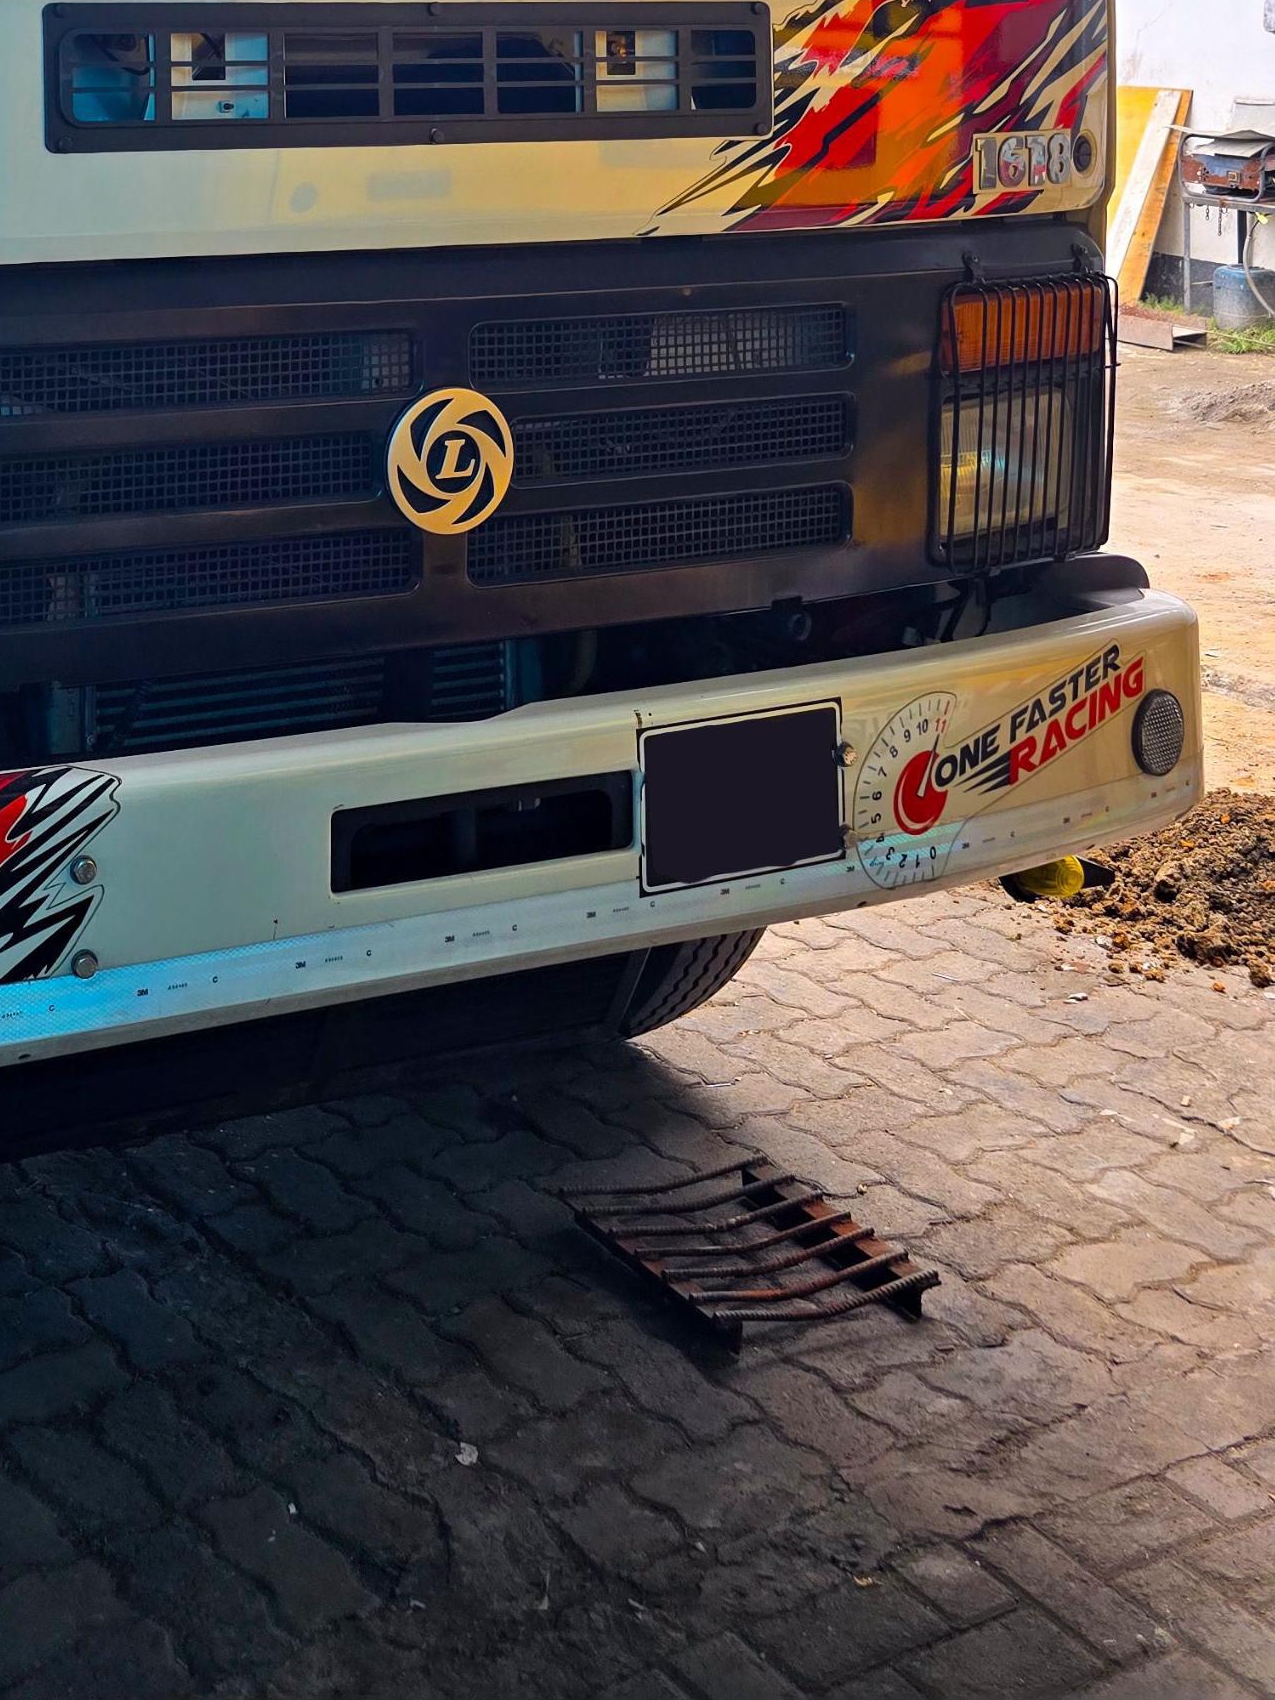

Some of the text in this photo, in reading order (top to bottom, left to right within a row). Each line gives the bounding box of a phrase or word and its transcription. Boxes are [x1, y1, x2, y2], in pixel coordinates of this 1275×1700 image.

[975, 132, 1071, 190] 1618
[435, 439, 476, 480] L
[934, 643, 1122, 788] ONE FASTER
[1009, 656, 1145, 786] RACING
[916, 718, 929, 736] 10
[934, 717, 947, 734] 11
[903, 729, 912, 743] 9
[889, 746, 899, 758] 8
[878, 766, 888, 778] 7
[872, 790, 882, 801] 6
[870, 812, 882, 824] 5
[885, 846, 895, 860] 3
[929, 846, 937, 860] 0
[898, 853, 908, 869] 2
